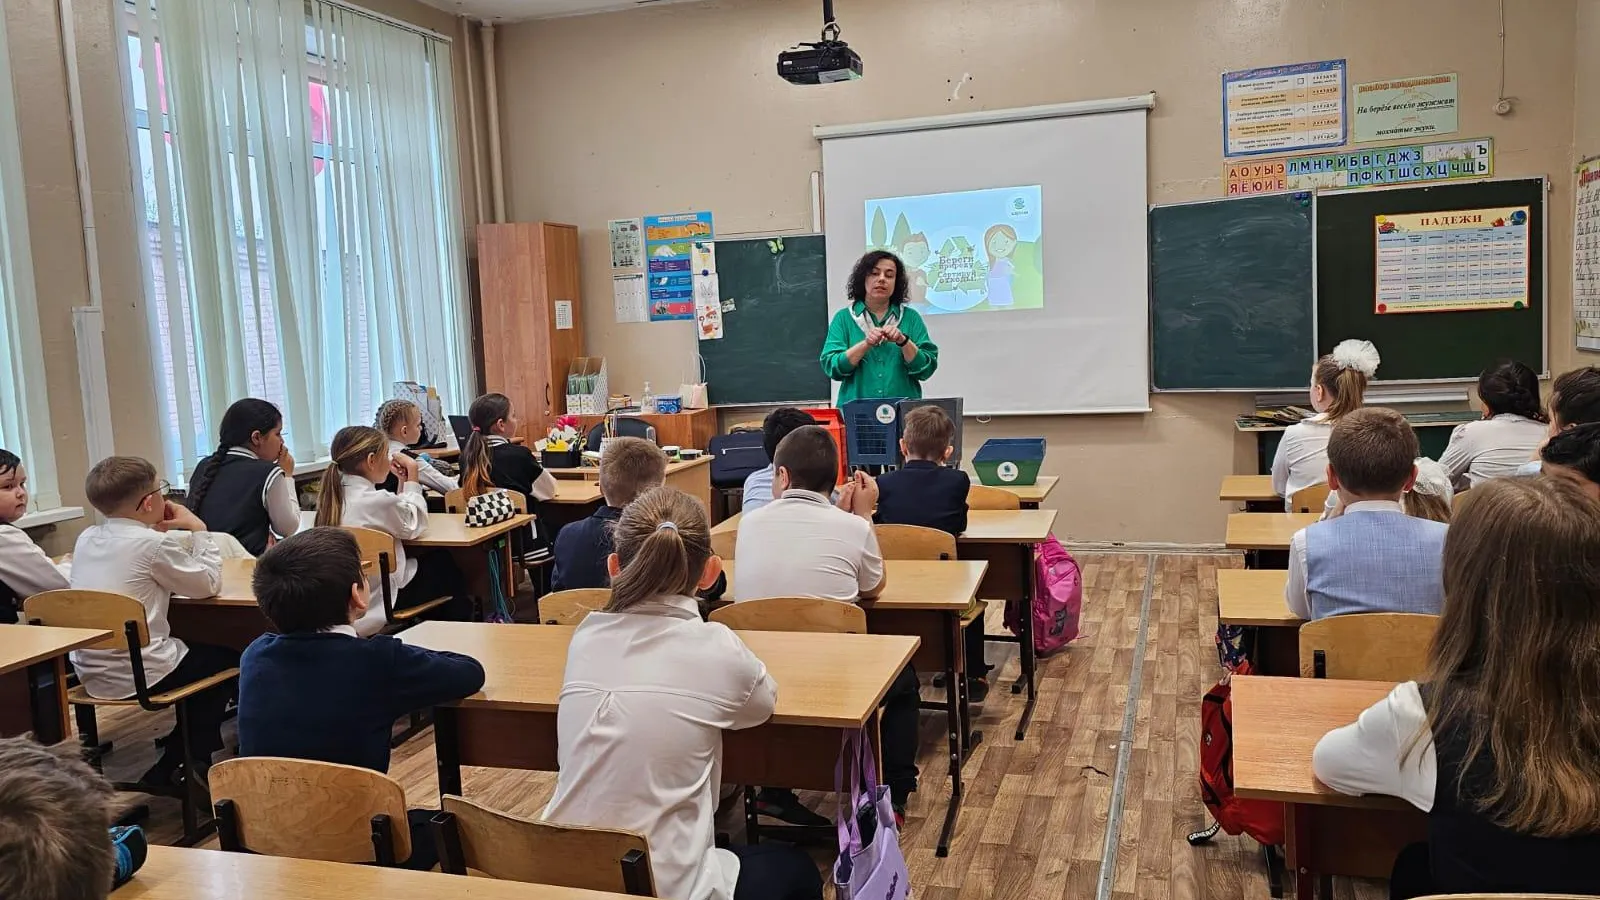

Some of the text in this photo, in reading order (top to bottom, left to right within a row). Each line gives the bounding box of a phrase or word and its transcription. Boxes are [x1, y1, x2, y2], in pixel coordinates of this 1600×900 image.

[1357, 106, 1368, 114] На
[1420, 214, 1482, 227] ПАДЕЖИ
[939, 256, 974, 265] Береги
